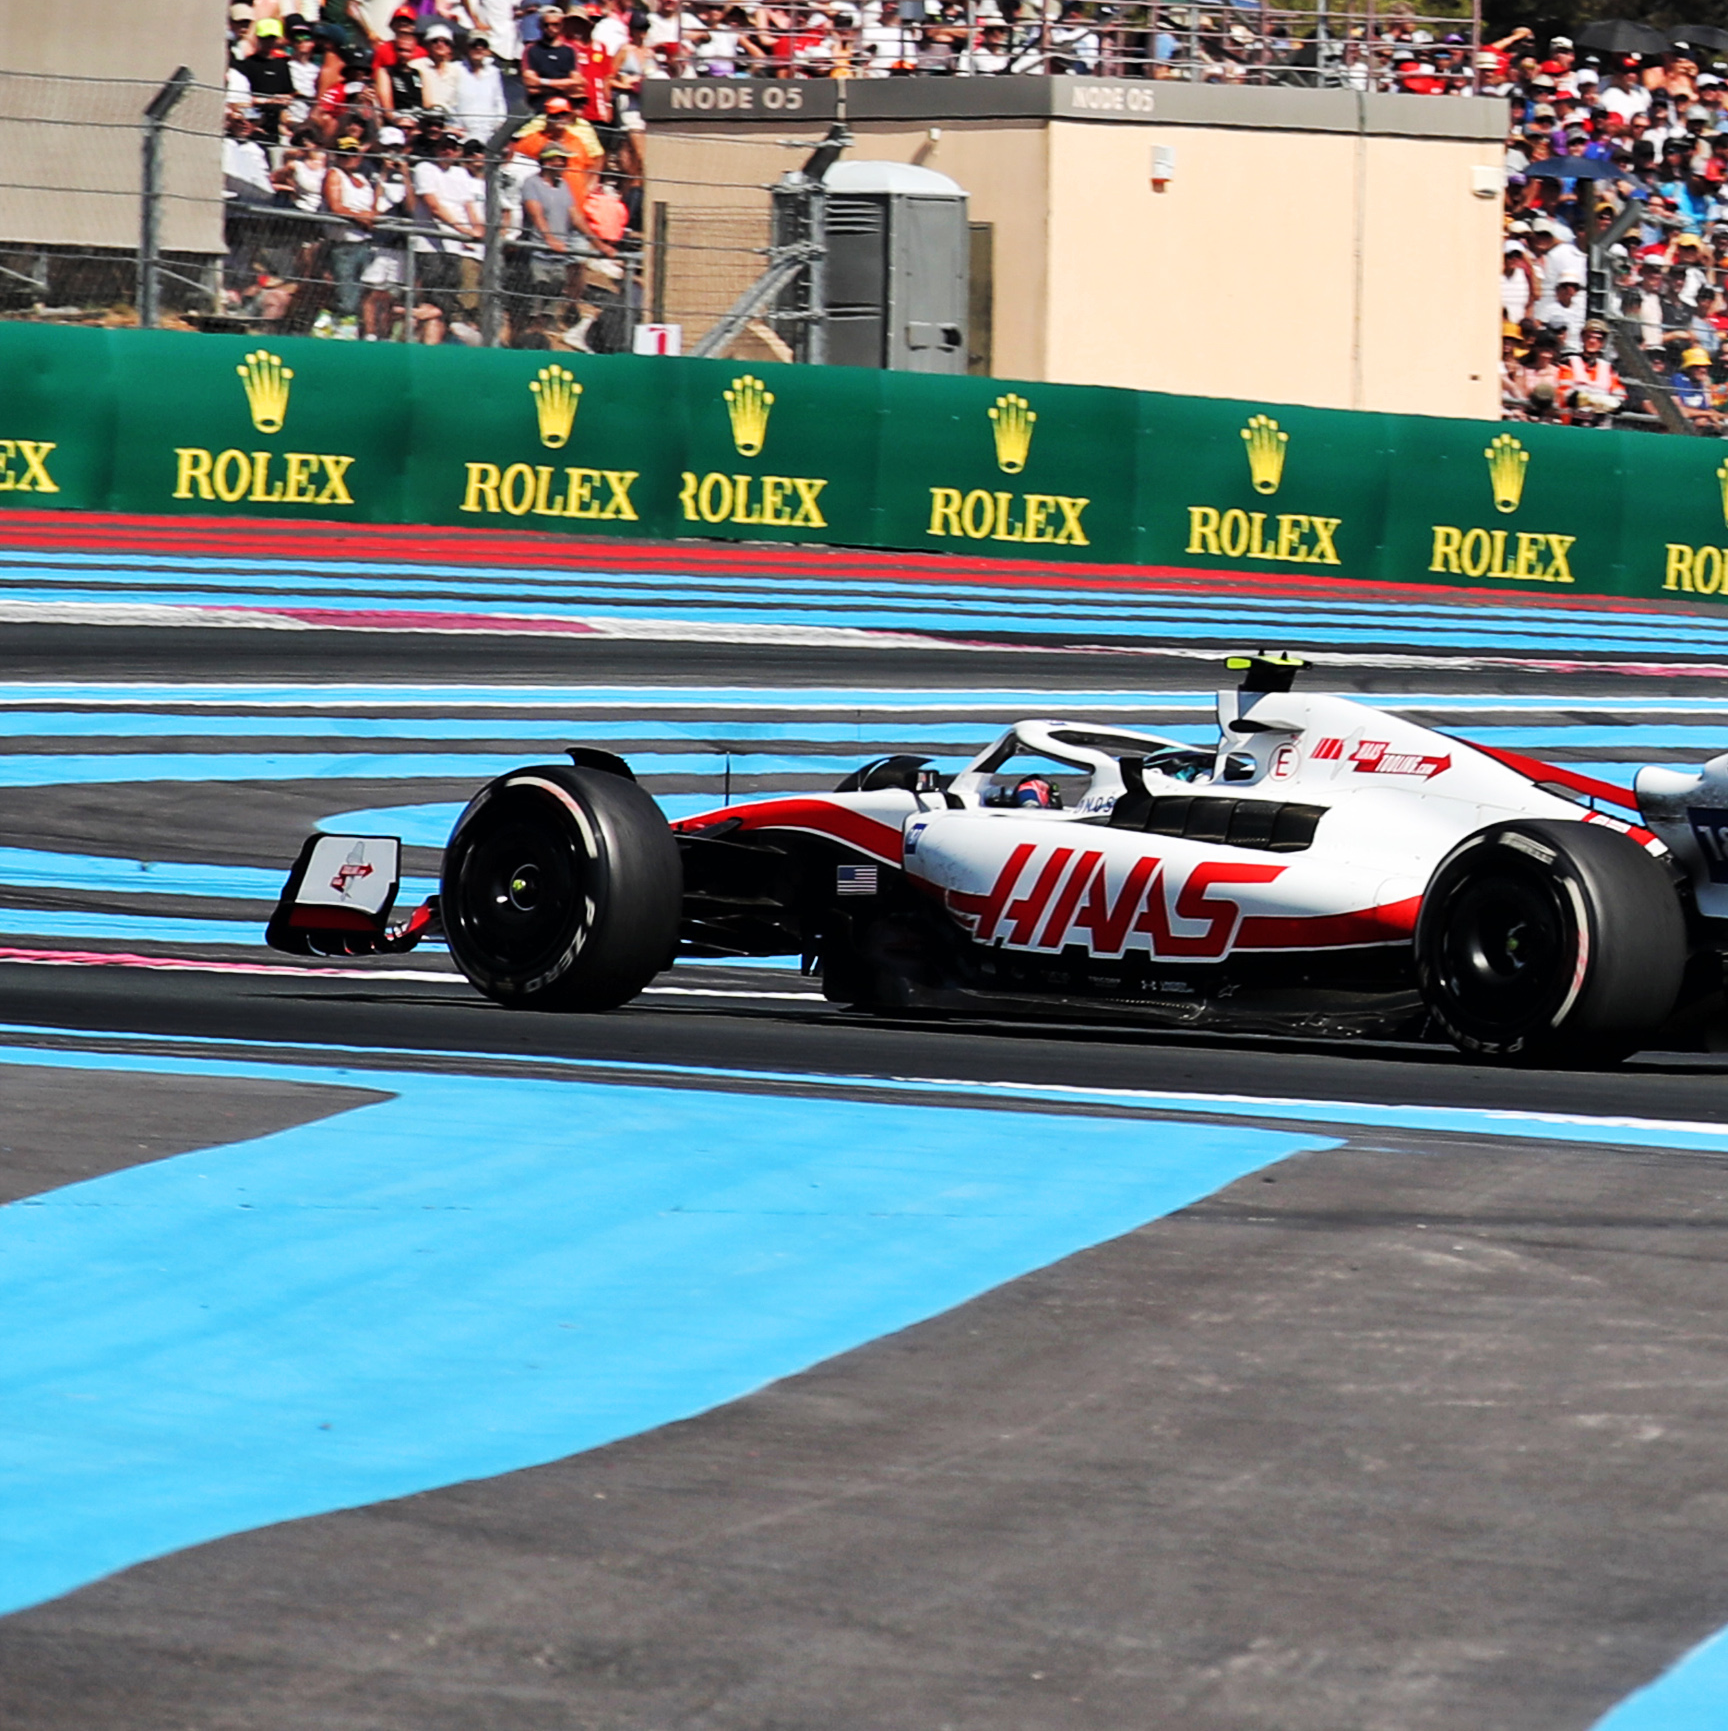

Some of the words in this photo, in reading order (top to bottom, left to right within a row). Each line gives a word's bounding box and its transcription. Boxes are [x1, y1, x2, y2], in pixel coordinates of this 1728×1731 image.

[671, 86, 754, 110] NODE
[761, 86, 803, 110] 05
[1072, 86, 1125, 111] NODE
[1126, 88, 1155, 113] 05
[176, 448, 355, 505] ROLEX
[462, 462, 640, 521] ROLEX
[929, 487, 1090, 546] ROLEX
[1187, 506, 1342, 565] ROLEX
[1431, 525, 1575, 583] ROLEX
[1275, 748, 1293, 777] E
[1354, 742, 1387, 761] HAAS
[946, 843, 1291, 958] HAAS
